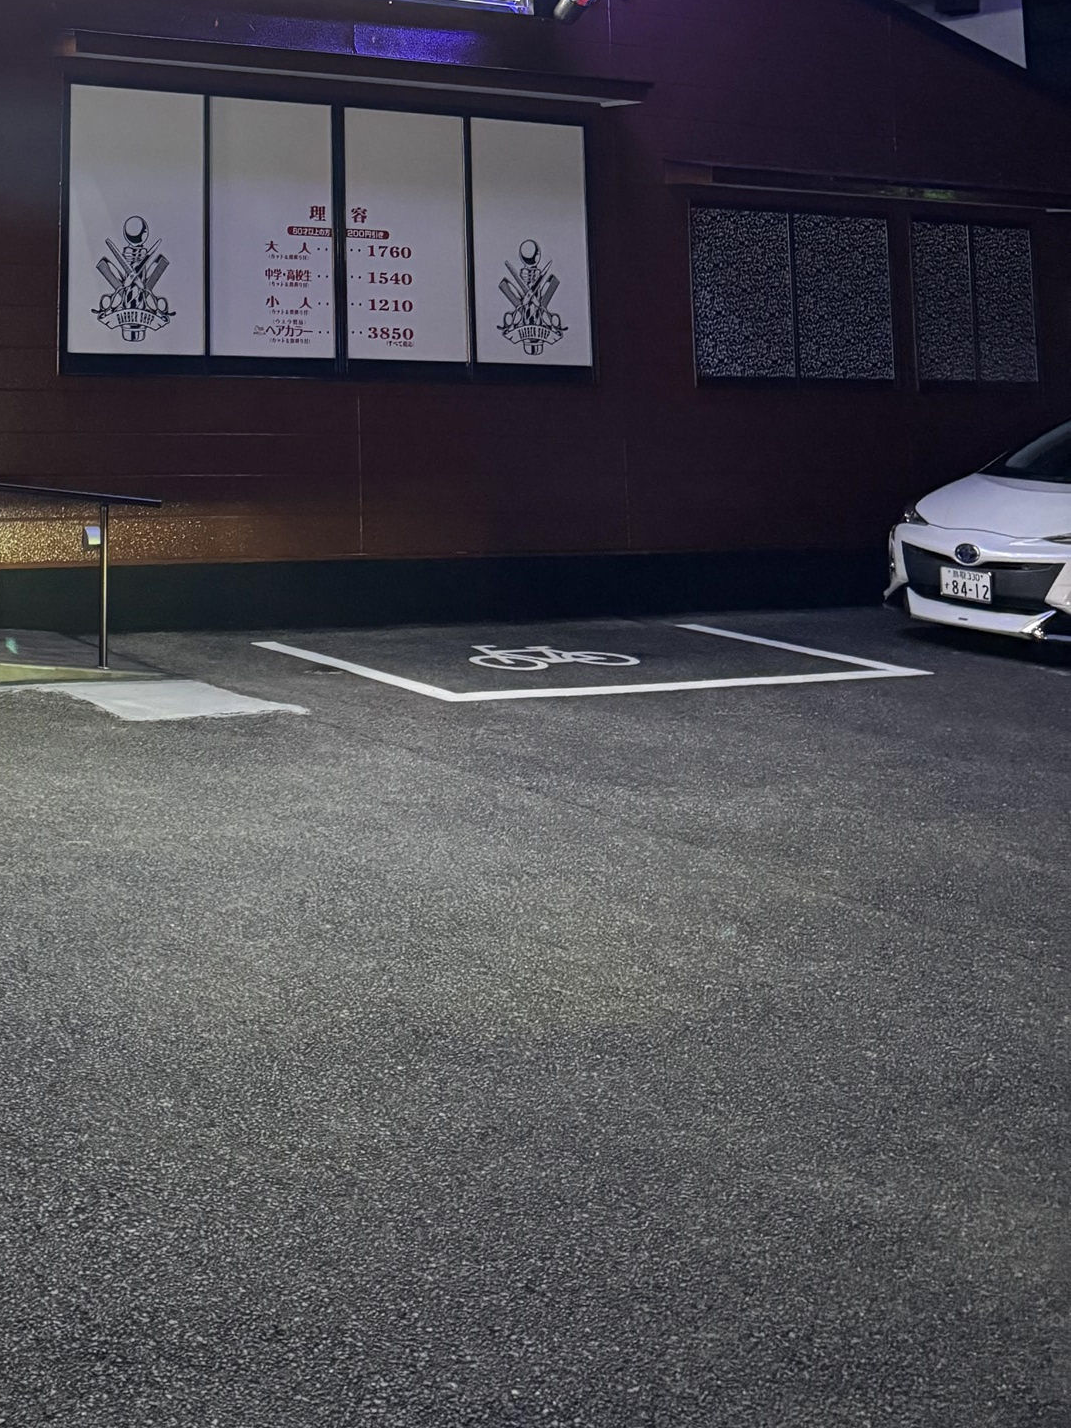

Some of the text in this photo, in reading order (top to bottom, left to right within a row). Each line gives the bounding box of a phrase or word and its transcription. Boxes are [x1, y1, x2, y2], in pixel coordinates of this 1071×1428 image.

[367, 244, 413, 260] 1760
[368, 271, 413, 286] 1540
[368, 298, 414, 313] 1210
[116, 311, 155, 326] BARBER SHOP
[265, 324, 314, 337] ヘアカラー
[367, 326, 414, 341] 3850
[538, 327, 551, 340] SHOP
[951, 579, 990, 600] 84-12
